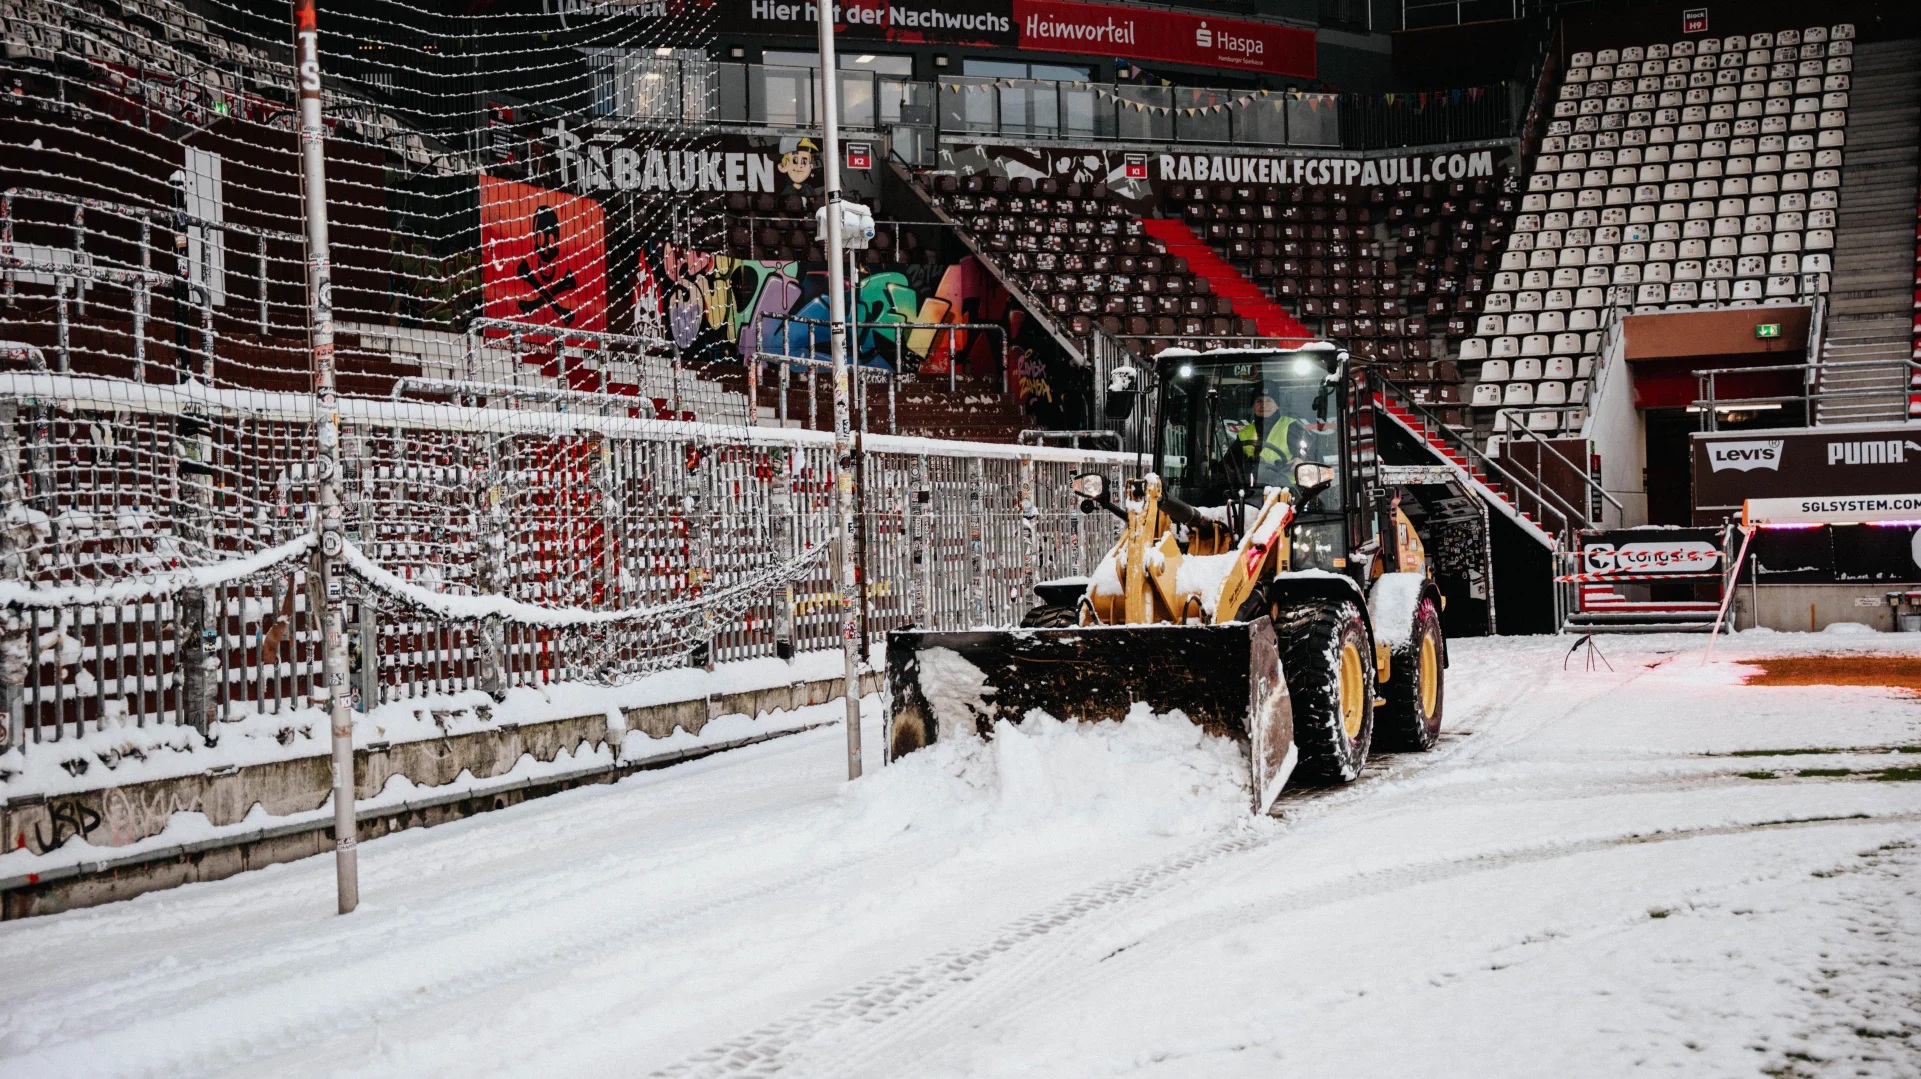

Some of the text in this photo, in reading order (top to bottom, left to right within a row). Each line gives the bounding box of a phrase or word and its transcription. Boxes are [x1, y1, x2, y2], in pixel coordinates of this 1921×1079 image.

[751, 0, 1010, 32] Hier ht der Nachwuchs
[1689, 22, 1702, 30] H9
[1026, 13, 1135, 46] Heimvorteil
[1217, 31, 1264, 56] Haspa
[542, 118, 775, 196] RABAUKEN
[1159, 151, 1494, 187] RABAUKEN.FCSTPAULI.COM
[1234, 364, 1252, 376] CAT
[1828, 440, 1904, 466] PUMA
[1802, 499, 1921, 513] SGLSYSTEM.COM
[1628, 548, 1703, 566] cong
